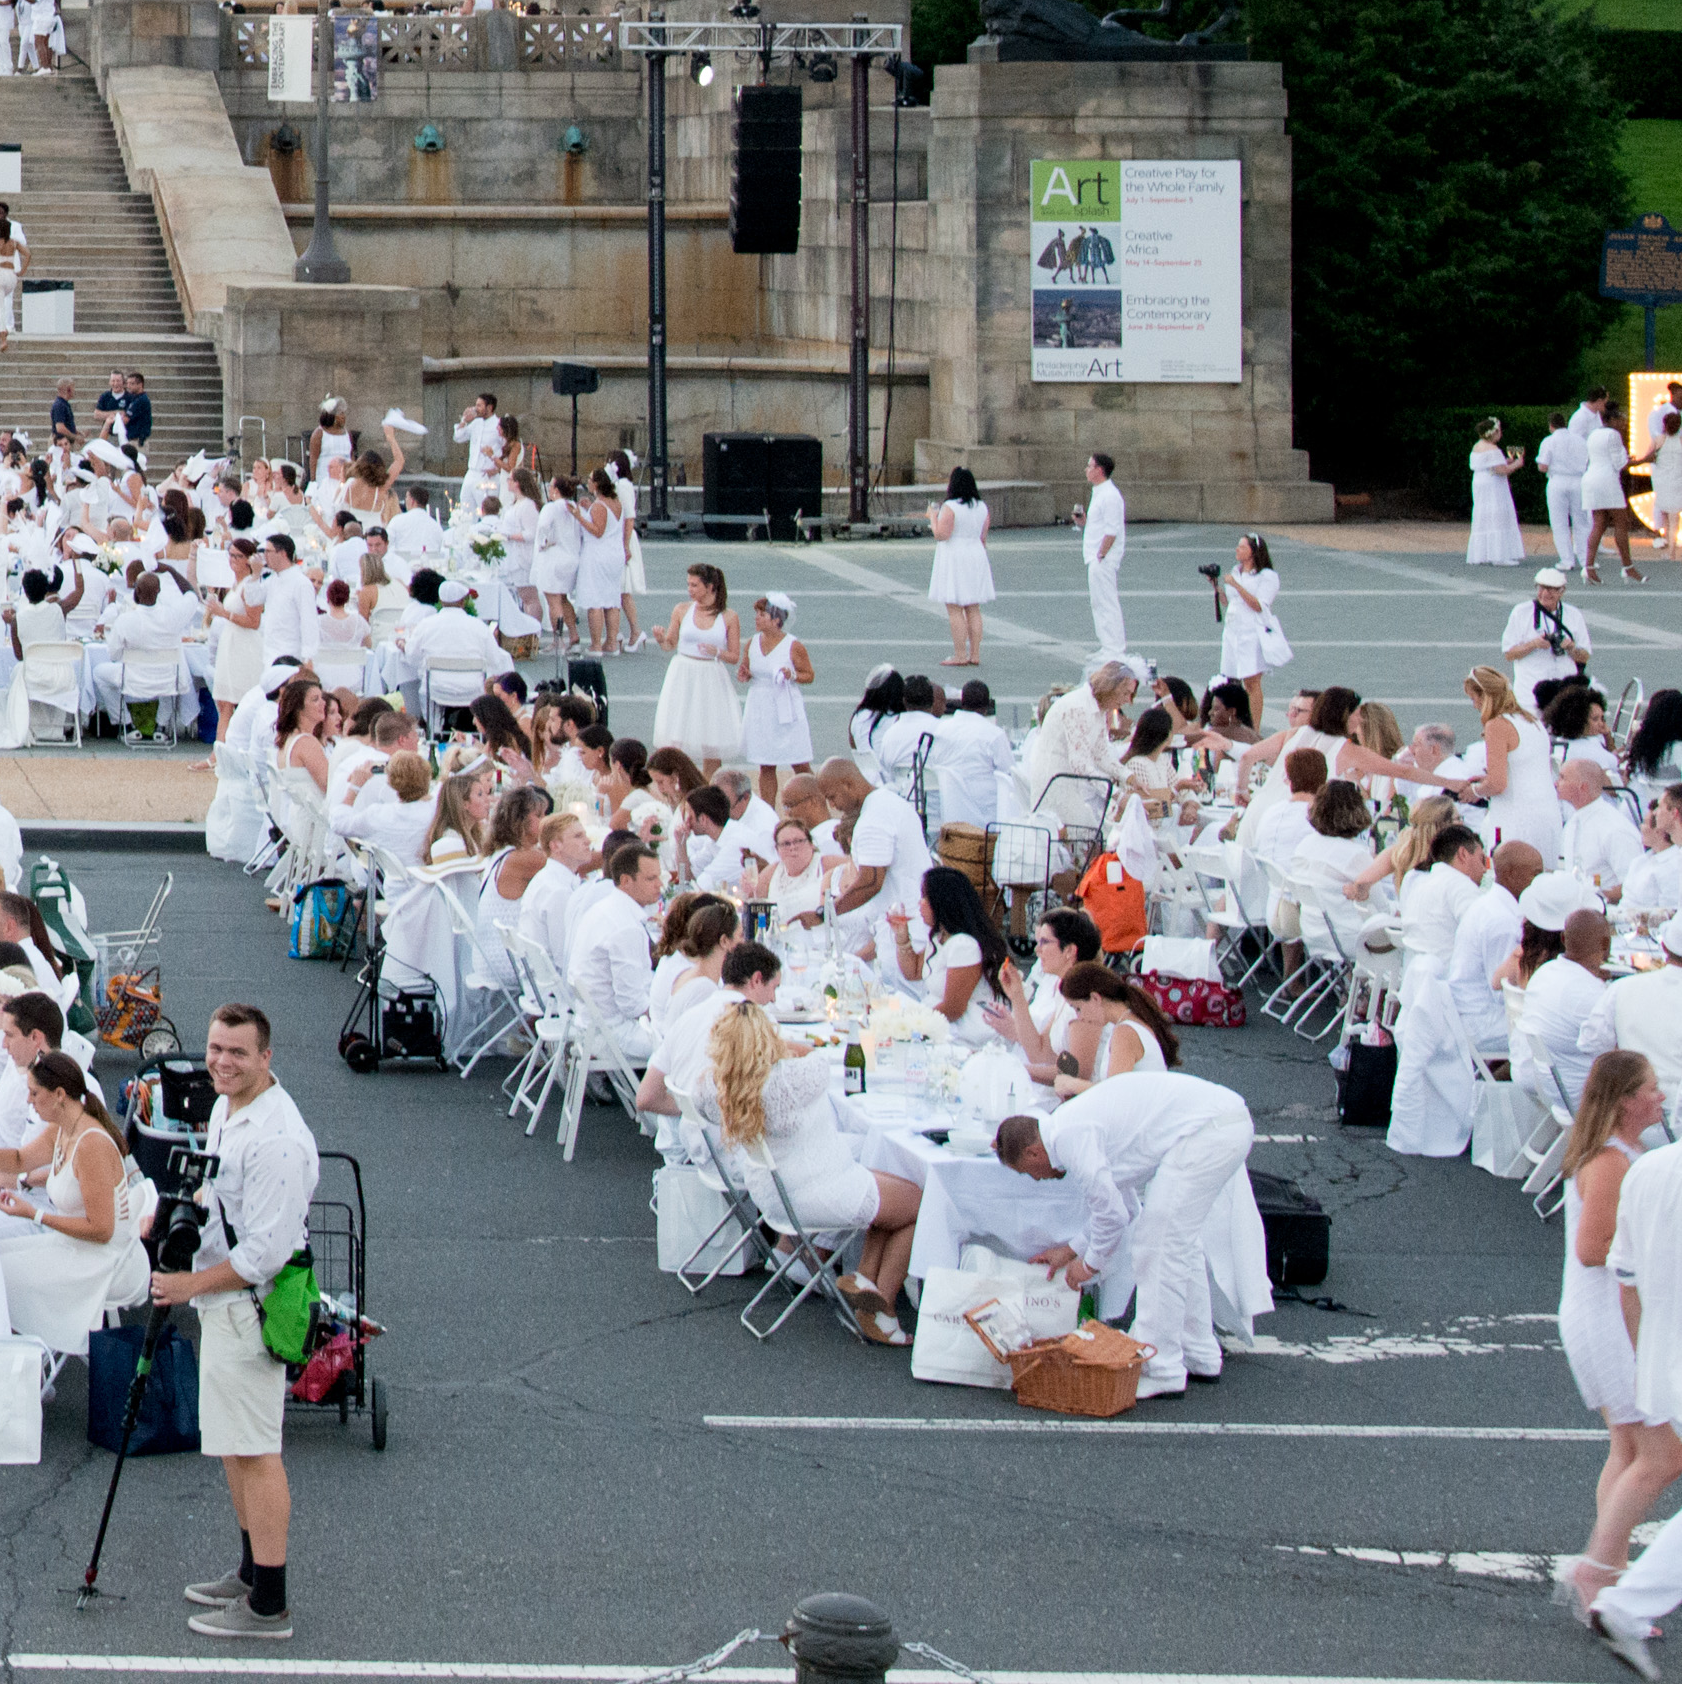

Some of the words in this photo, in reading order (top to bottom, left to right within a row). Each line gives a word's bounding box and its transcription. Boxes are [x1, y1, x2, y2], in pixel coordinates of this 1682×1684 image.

[277, 21, 285, 90] CONTEMPORARY
[1125, 167, 1172, 179] Creative
[1176, 167, 1197, 182] Play
[1201, 167, 1216, 179] for
[1040, 166, 1109, 206] Art
[1125, 181, 1144, 193] the
[1147, 181, 1185, 193] Whole
[1188, 181, 1225, 195] Family
[1125, 230, 1172, 241] Creative
[1125, 244, 1158, 255] Africa
[1126, 294, 1188, 309] Embracing
[1191, 294, 1210, 306] the
[1126, 309, 1211, 324] Contemporary
[1036, 362, 1088, 371] Philadelphia
[1087, 358, 1123, 378] Art
